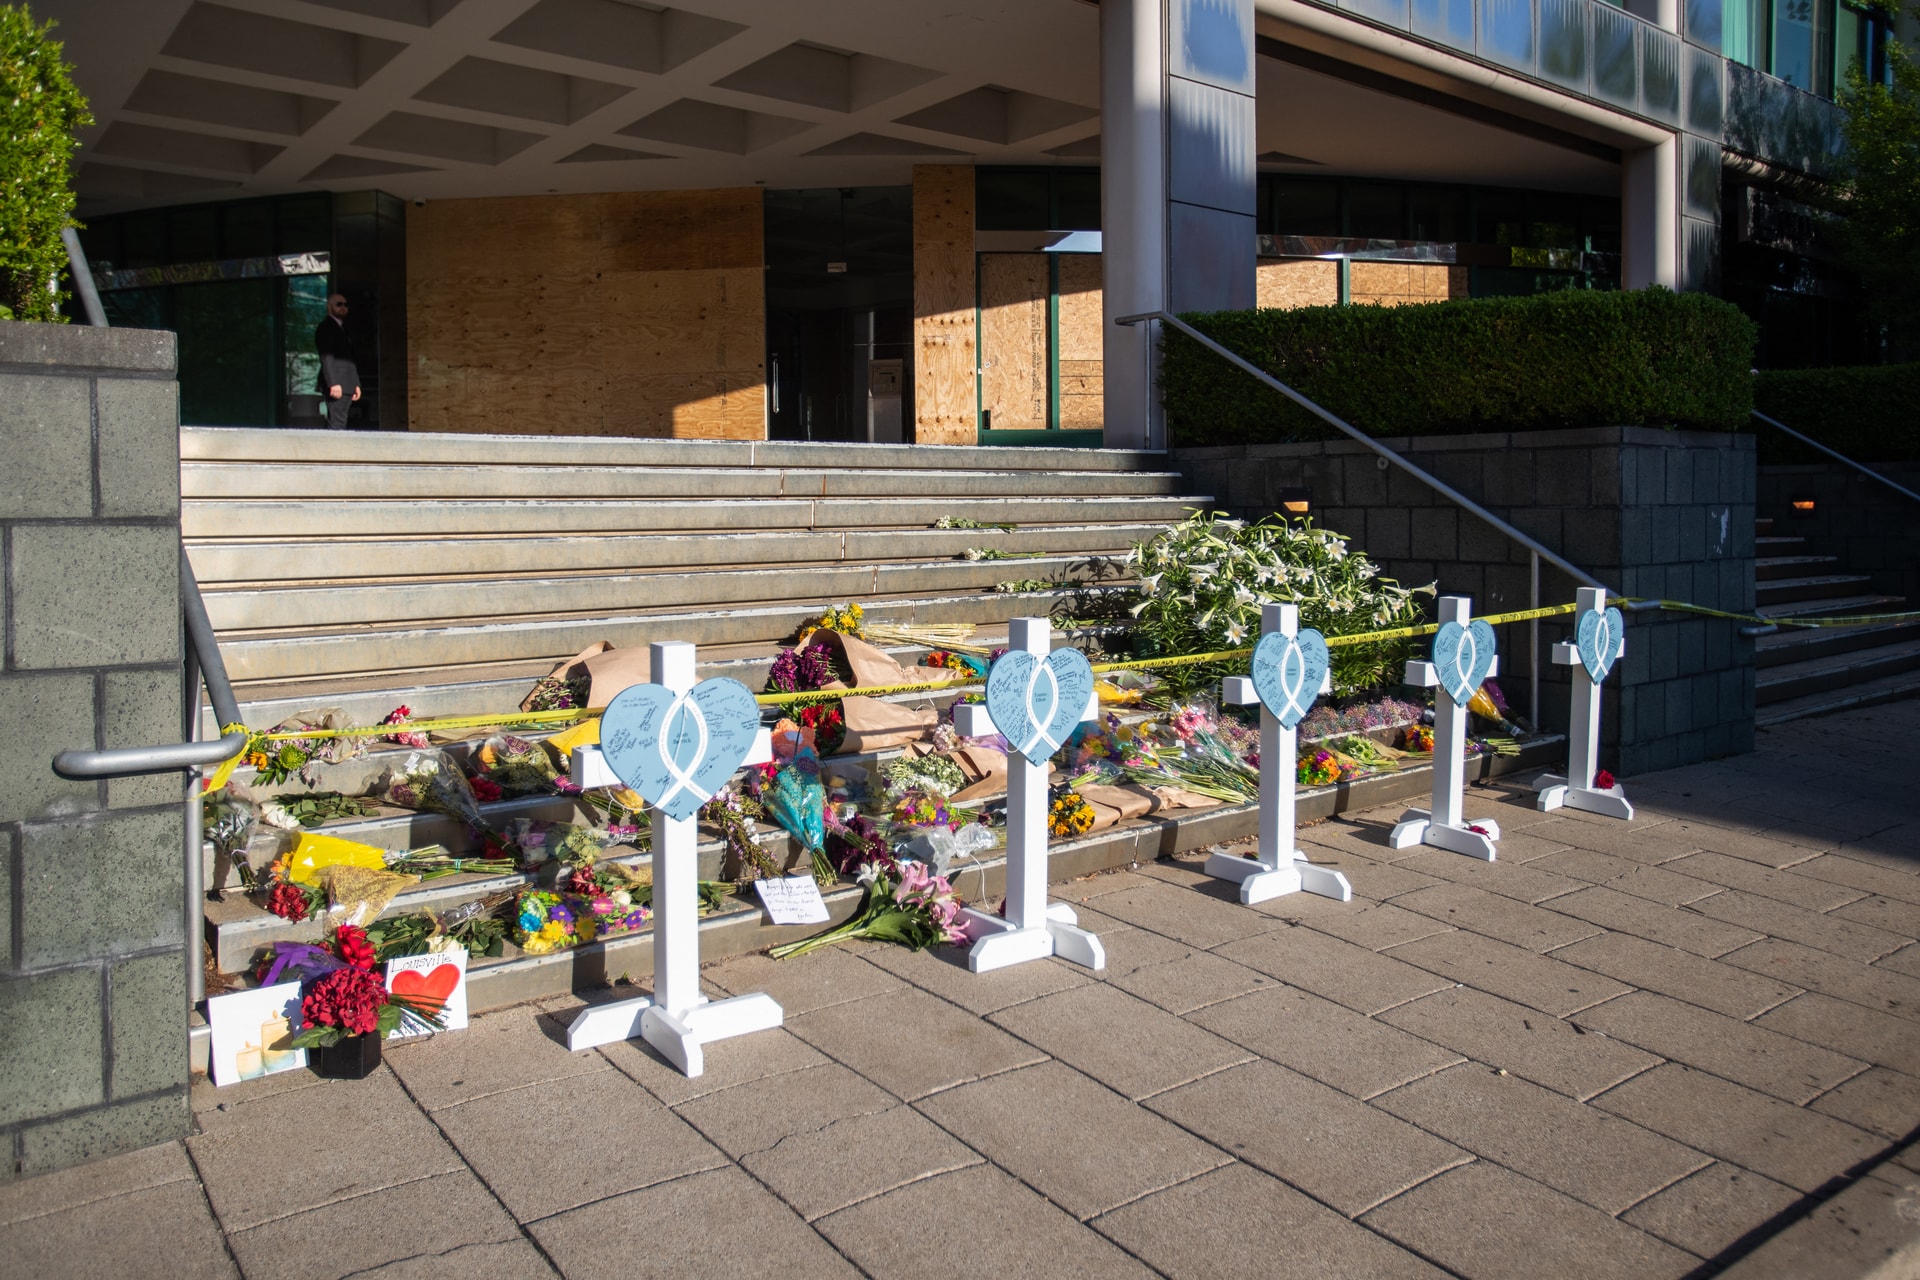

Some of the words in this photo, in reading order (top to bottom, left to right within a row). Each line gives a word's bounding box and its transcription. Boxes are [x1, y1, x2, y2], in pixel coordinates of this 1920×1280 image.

[795, 693, 839, 702] CAUTION
[892, 685, 932, 694] CAUTION
[391, 954, 452, 972] Louisville
